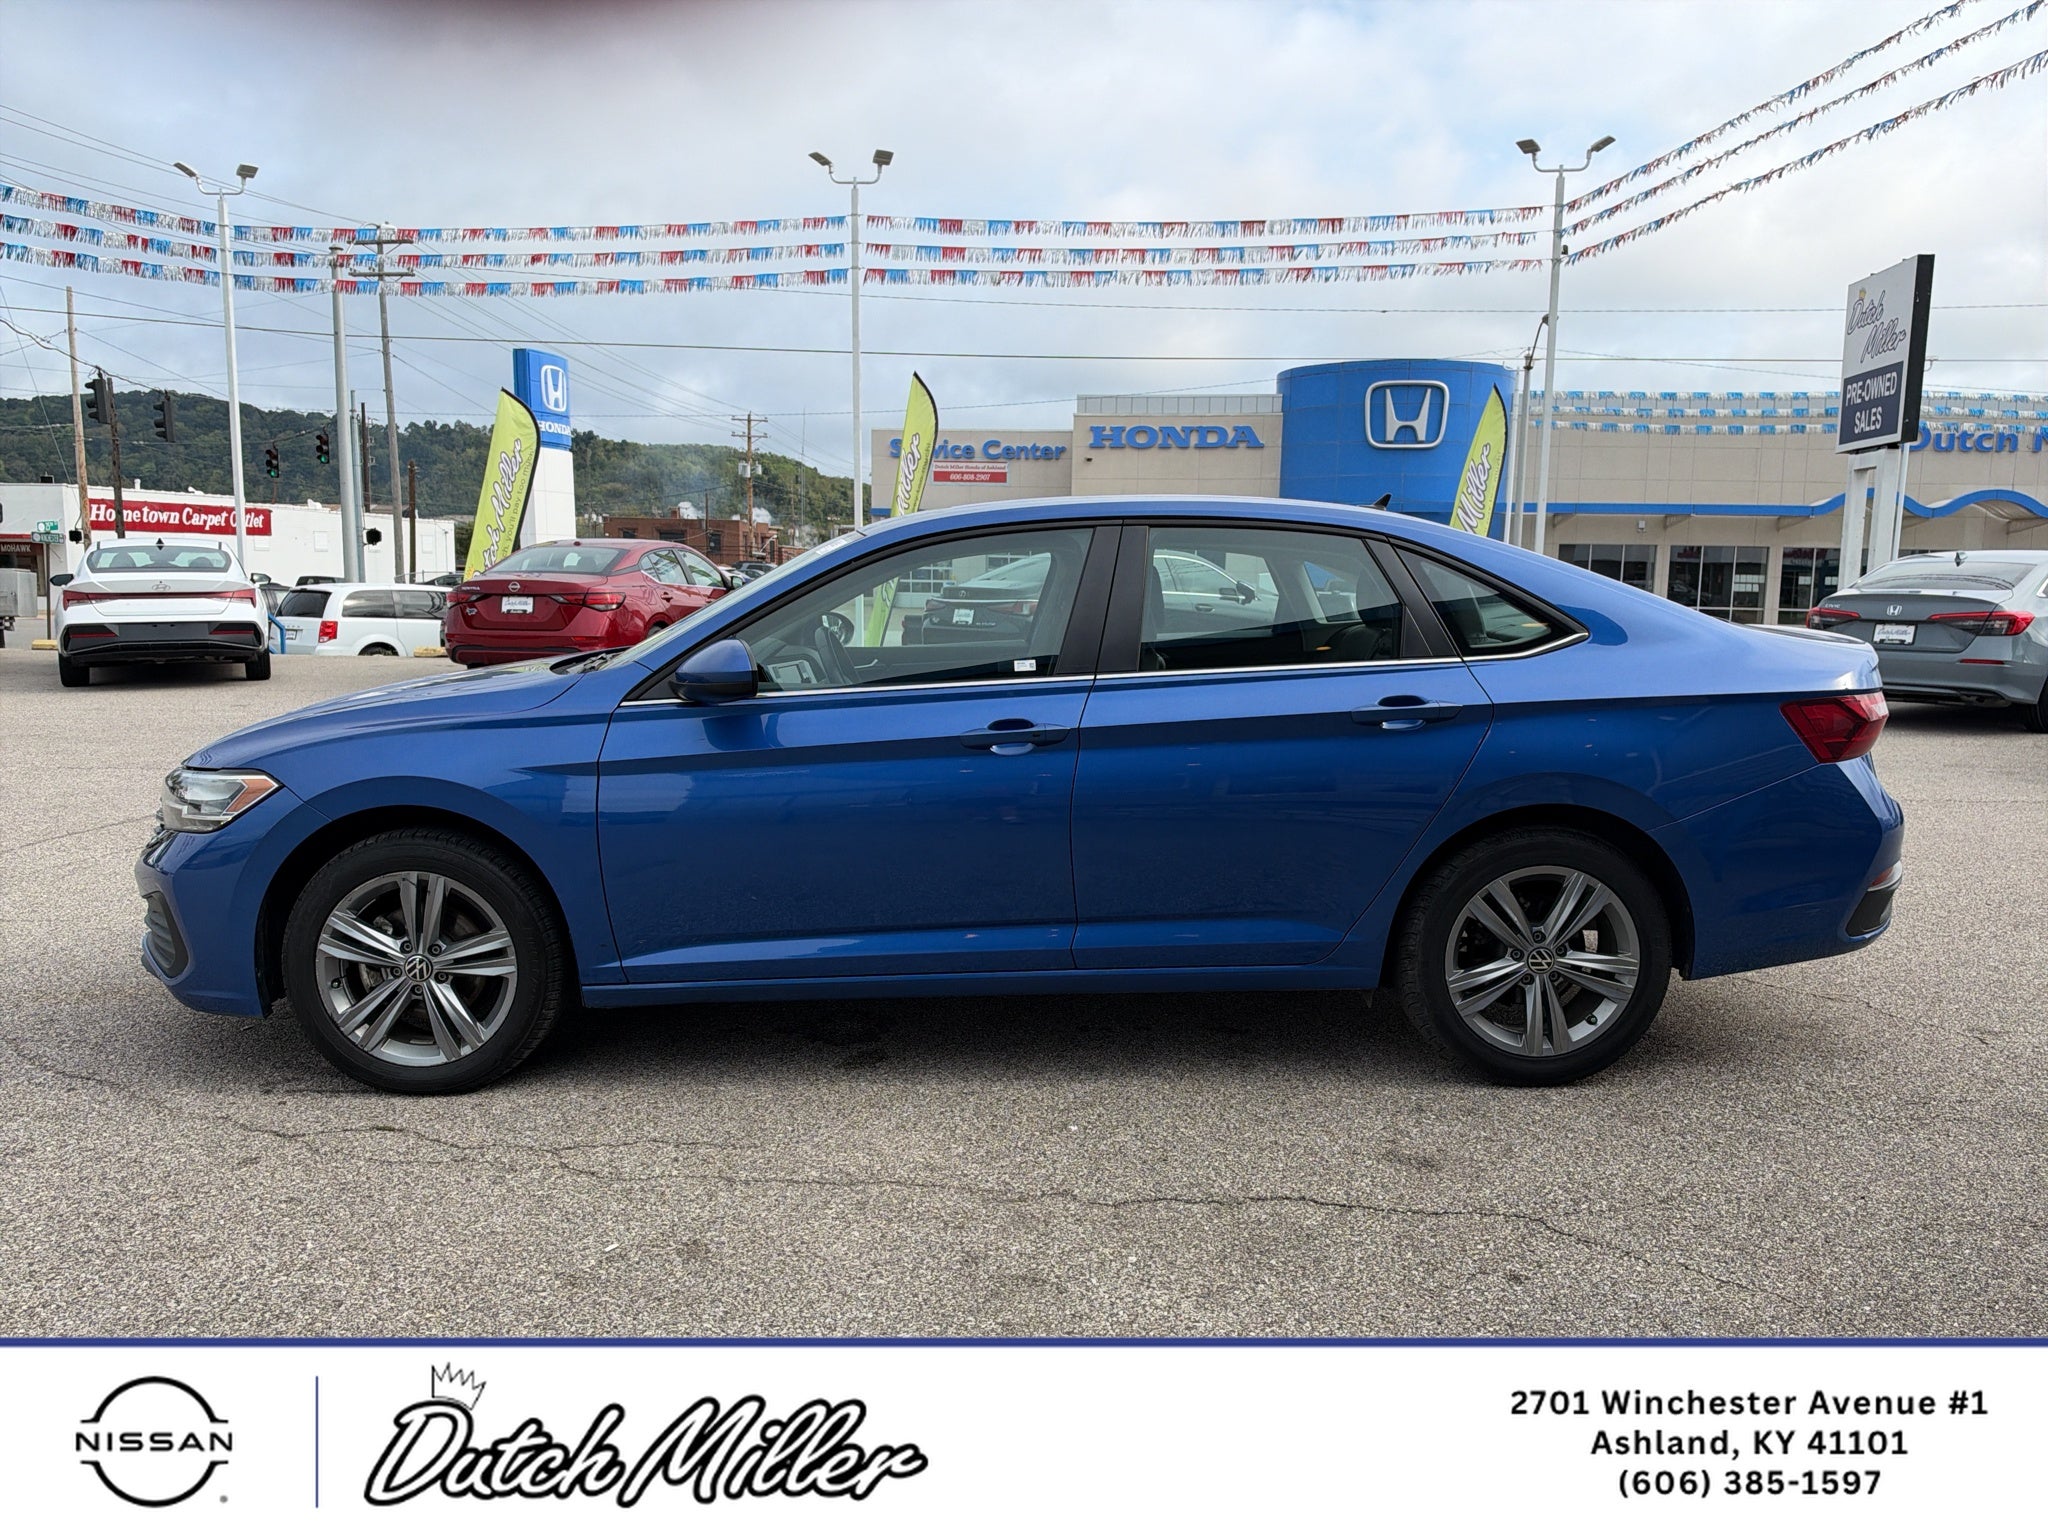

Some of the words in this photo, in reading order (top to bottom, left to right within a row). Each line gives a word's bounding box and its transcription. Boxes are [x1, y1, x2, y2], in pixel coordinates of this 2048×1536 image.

[1847, 290, 1886, 335] Dutch
[1860, 317, 1907, 364] Miller
[1845, 371, 1898, 407] PRE-OWNED
[1853, 406, 1883, 435] SALES
[889, 437, 976, 460] Svice
[982, 439, 1067, 460] Center
[1089, 425, 1265, 449] HONDA
[490, 438, 523, 533] Miller
[1457, 442, 1491, 535] Miller
[89, 503, 180, 525] Hometown
[182, 507, 228, 530] Carpet
[229, 510, 264, 529] Otlet
[0, 543, 32, 553] MOHAWK
